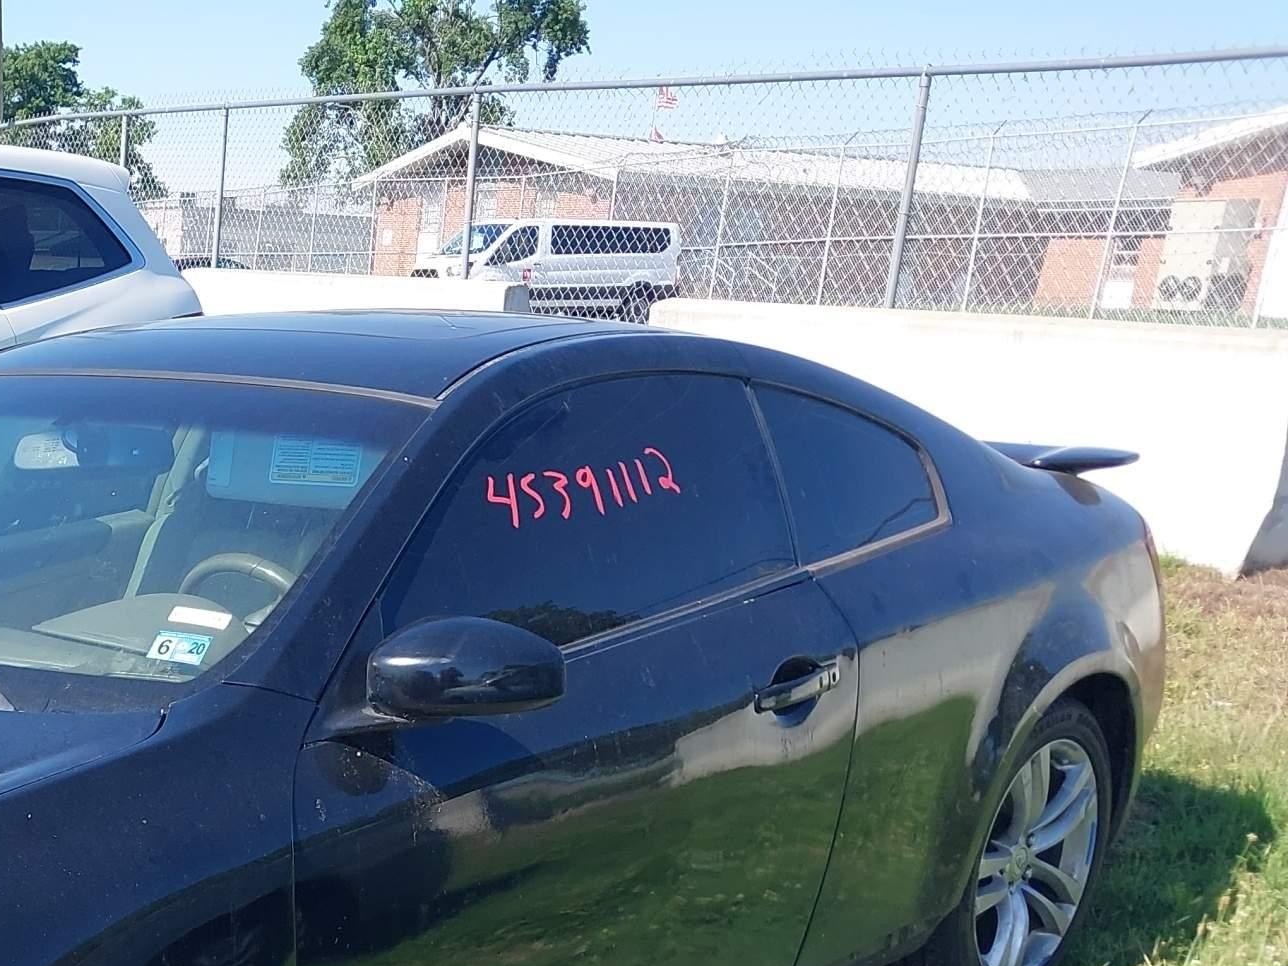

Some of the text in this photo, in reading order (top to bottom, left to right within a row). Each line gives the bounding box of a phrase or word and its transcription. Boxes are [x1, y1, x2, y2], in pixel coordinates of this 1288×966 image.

[487, 447, 681, 529] 45391112
[157, 639, 172, 655] 6
[188, 641, 206, 655] 20
